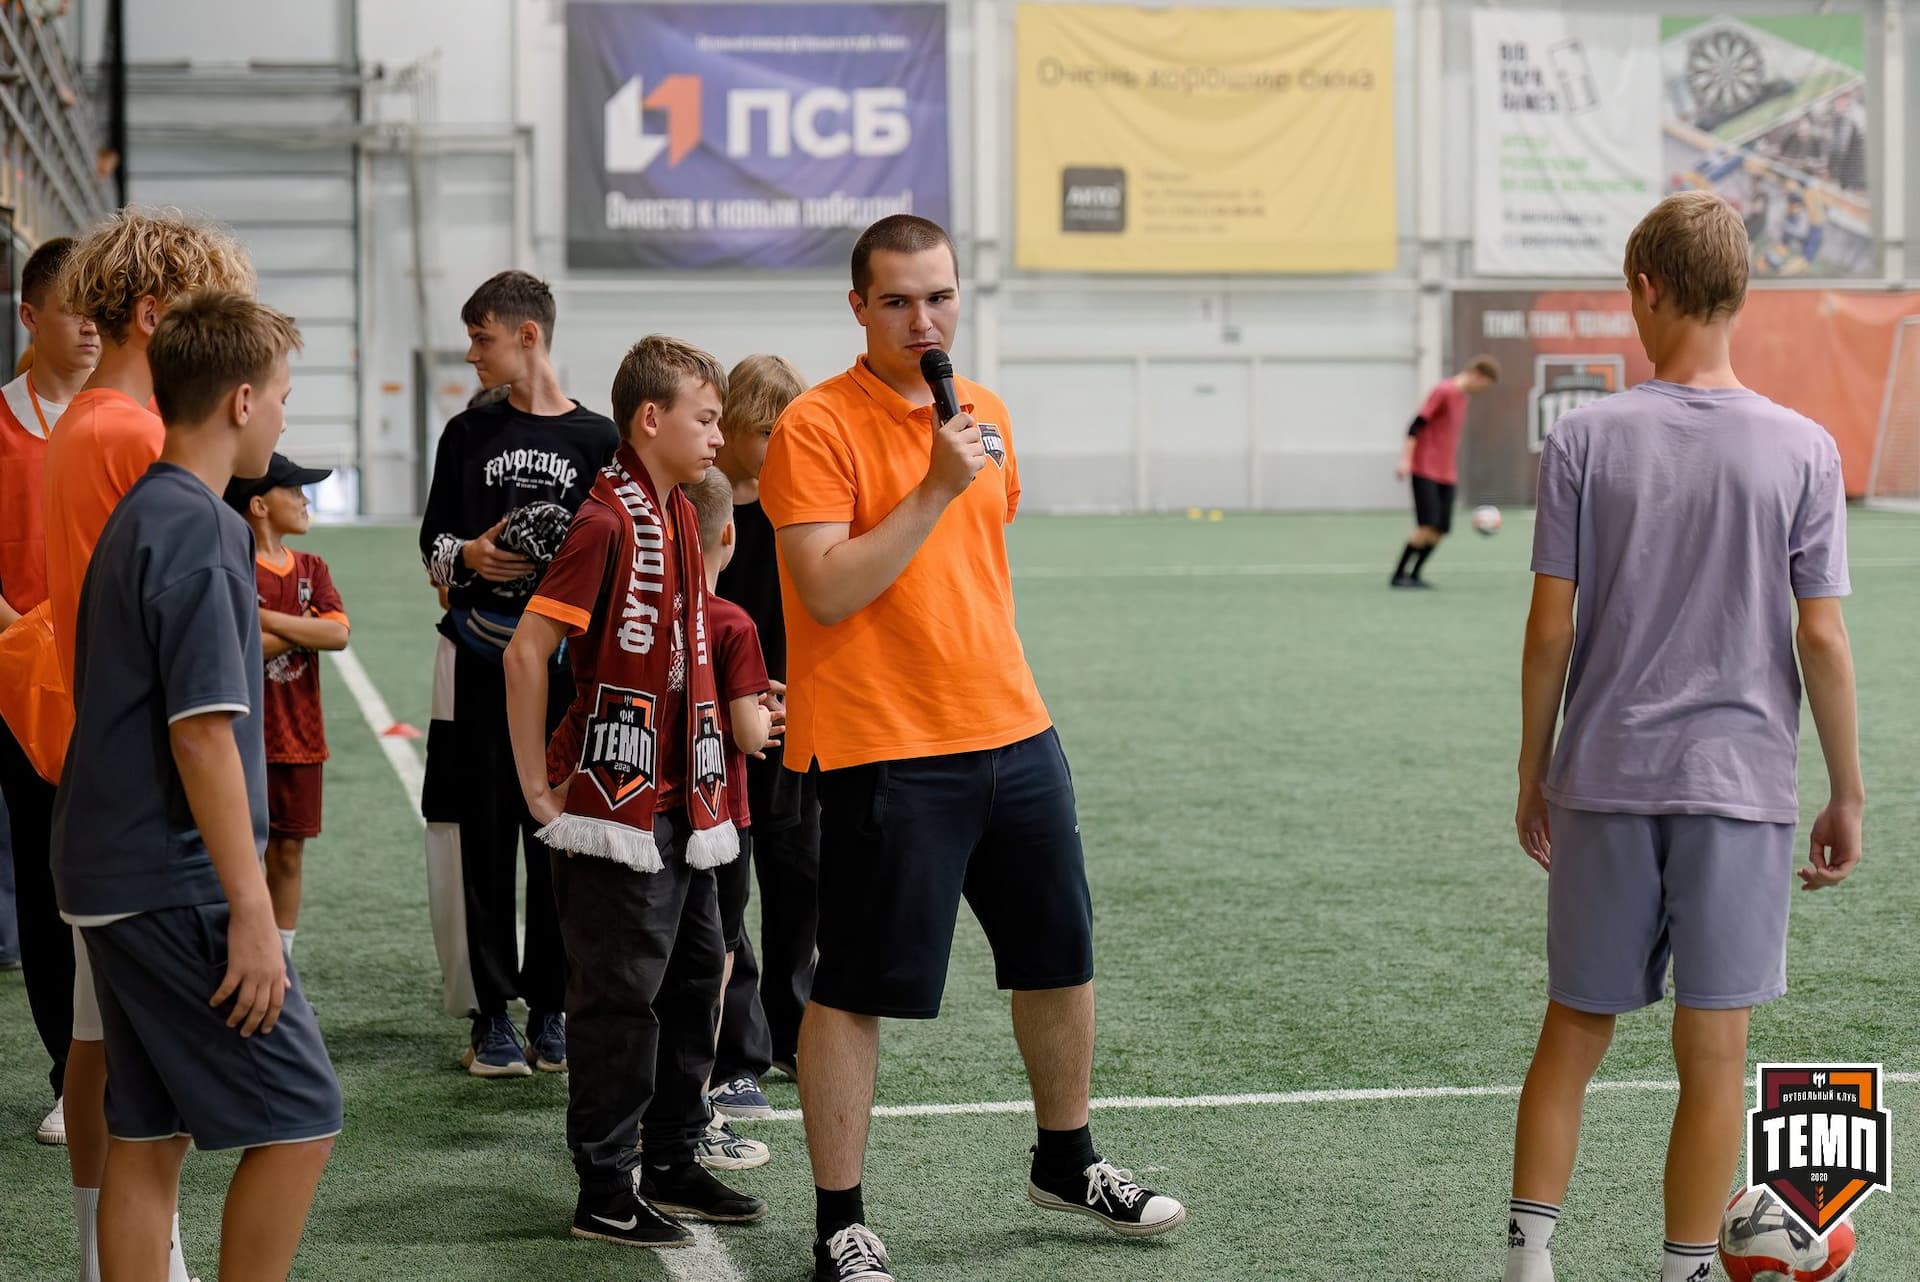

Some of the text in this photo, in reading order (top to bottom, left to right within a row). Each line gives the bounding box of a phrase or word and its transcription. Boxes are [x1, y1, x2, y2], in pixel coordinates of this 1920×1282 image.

[727, 87, 911, 158] ПСБ
[606, 191, 694, 229] Вместе
[698, 199, 712, 228] к
[716, 198, 799, 228] новым
[483, 449, 577, 499] favorable
[619, 709, 635, 724] ФК
[593, 721, 651, 775] ТЕМП
[614, 762, 631, 773] 2020
[696, 737, 722, 779] ТЕМП
